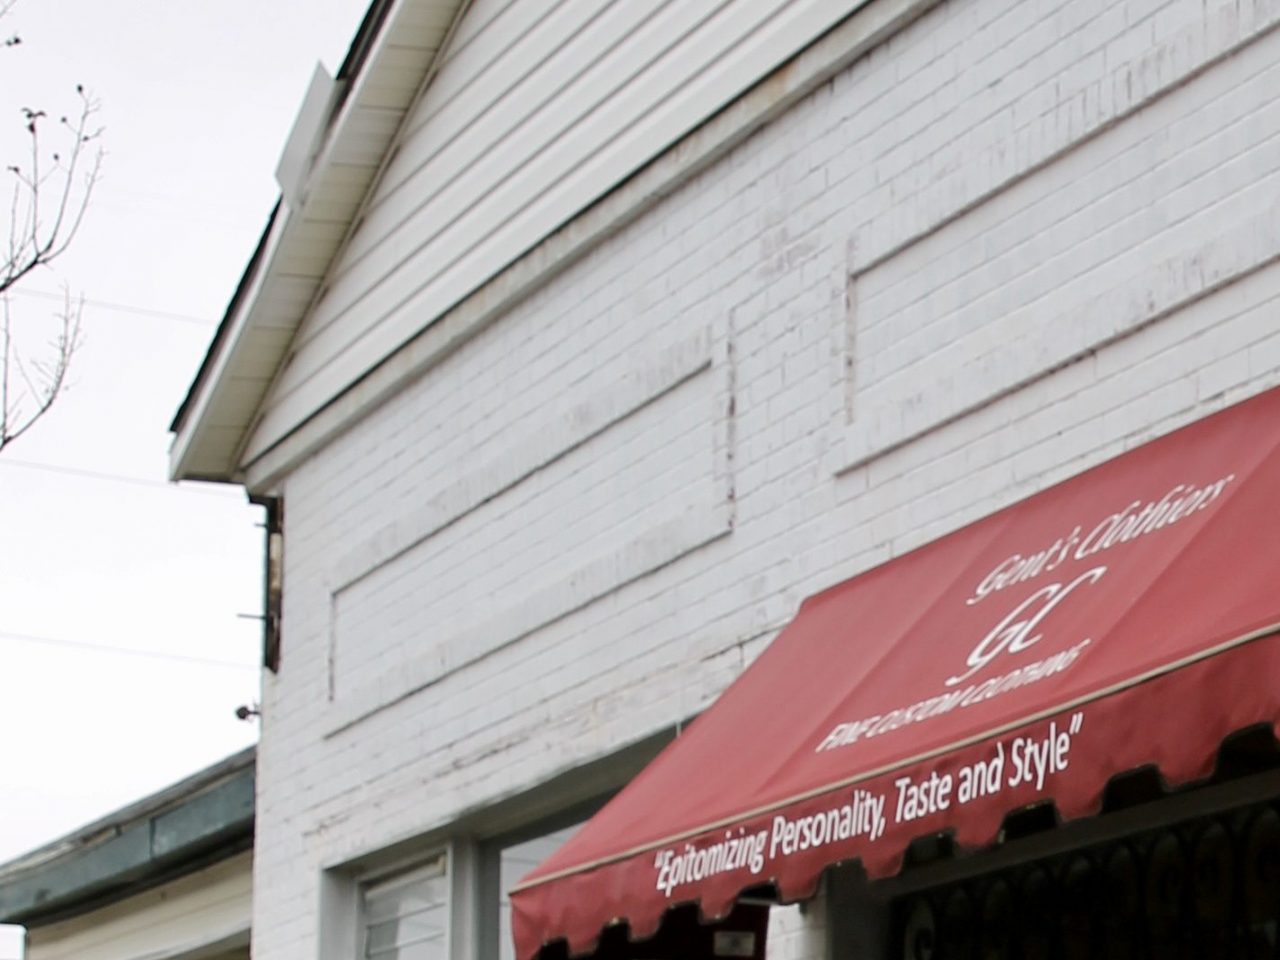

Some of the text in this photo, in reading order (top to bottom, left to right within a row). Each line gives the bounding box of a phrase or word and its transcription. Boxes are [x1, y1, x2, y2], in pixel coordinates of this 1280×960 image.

[966, 474, 1235, 605] Gent's Clothiers
[654, 712, 1083, 897] "Epitomizing Personality, Taste and Style"
